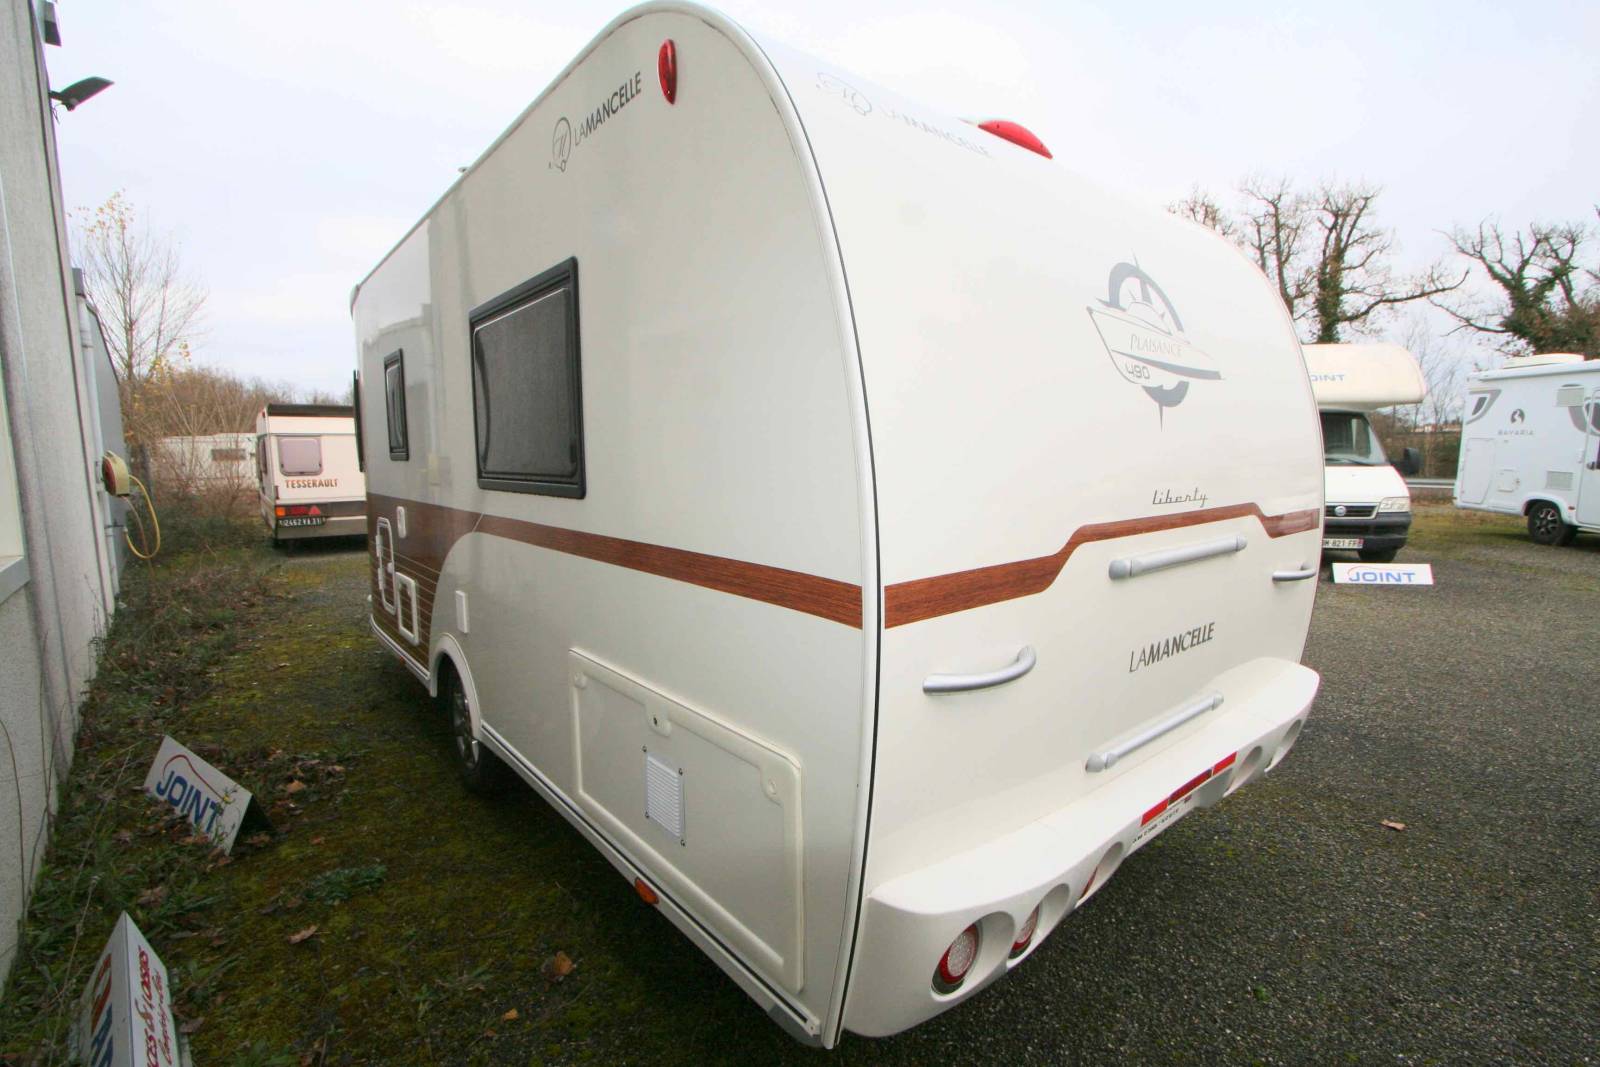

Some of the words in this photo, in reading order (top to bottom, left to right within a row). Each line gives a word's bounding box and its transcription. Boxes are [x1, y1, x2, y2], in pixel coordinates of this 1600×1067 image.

[574, 71, 642, 146] LAMANCELLE
[1125, 363, 1150, 380] 490
[286, 479, 338, 488] TESSERAULT
[1349, 571, 1416, 583] JOINT
[1129, 621, 1215, 673] LAMANCELLE
[156, 770, 221, 834] JOINT
